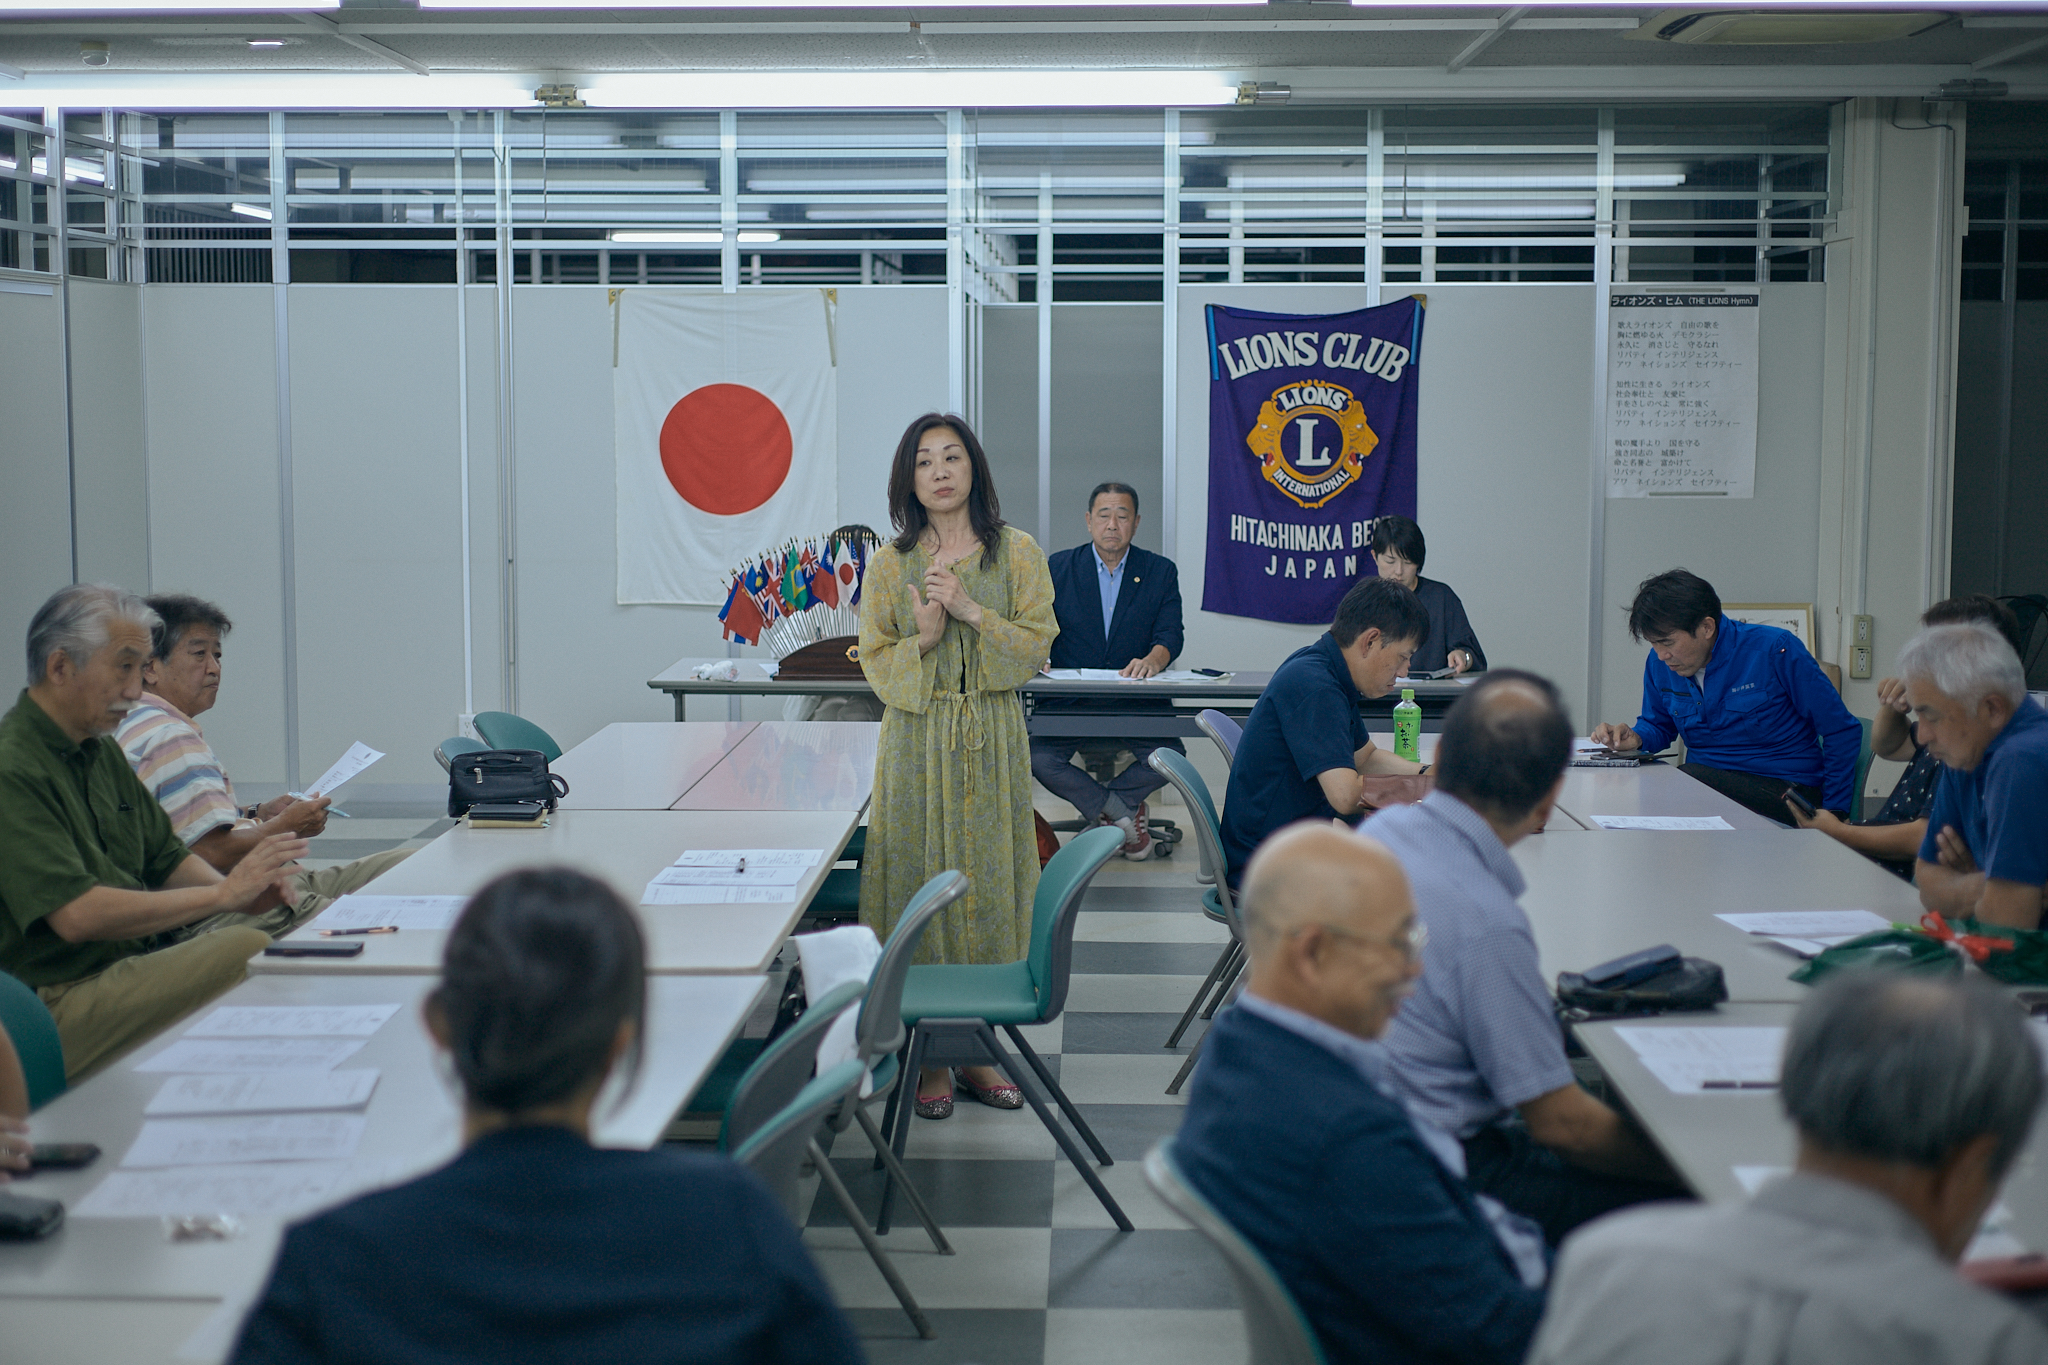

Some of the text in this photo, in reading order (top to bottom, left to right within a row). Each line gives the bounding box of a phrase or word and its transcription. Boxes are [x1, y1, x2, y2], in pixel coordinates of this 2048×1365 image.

[1218, 331, 1410, 383] LIONS CLUB
[1278, 387, 1347, 411] LIONS
[1296, 418, 1331, 466] L
[1272, 468, 1350, 498] INTERNATIONAL
[1613, 478, 1628, 486] アワ
[1230, 514, 1393, 551] HITACHINAKA BE
[1264, 554, 1357, 579] JAPAN
